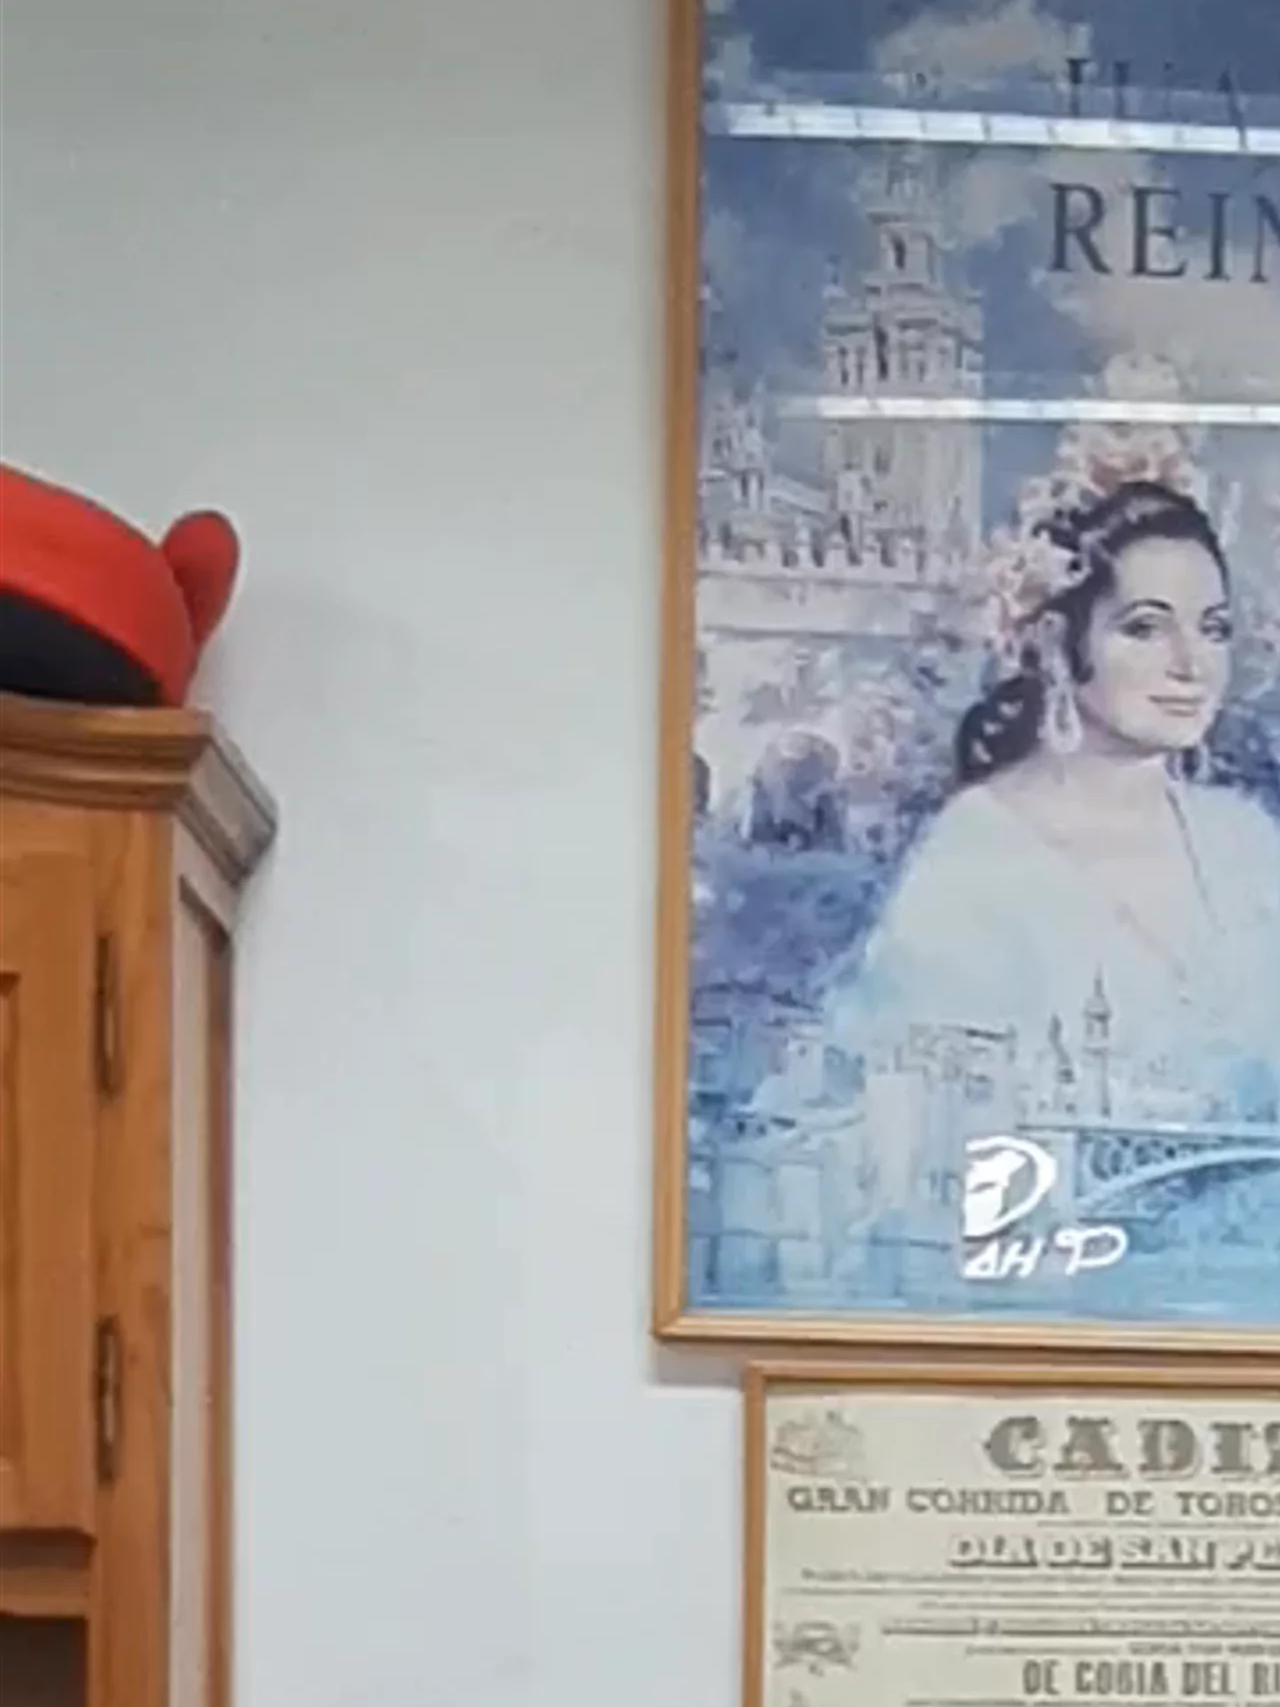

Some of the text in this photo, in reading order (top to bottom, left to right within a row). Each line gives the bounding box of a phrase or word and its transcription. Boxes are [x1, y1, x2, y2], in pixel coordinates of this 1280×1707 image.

[787, 1486, 889, 1515] GRAN
[906, 1487, 1071, 1515] CORRIDA
[1106, 1489, 1153, 1516] DE
[1046, 1534, 1113, 1569] DE
[1120, 1535, 1216, 1570] SAN
[1022, 1659, 1061, 1695] DE
[1181, 1661, 1236, 1696] DEL
